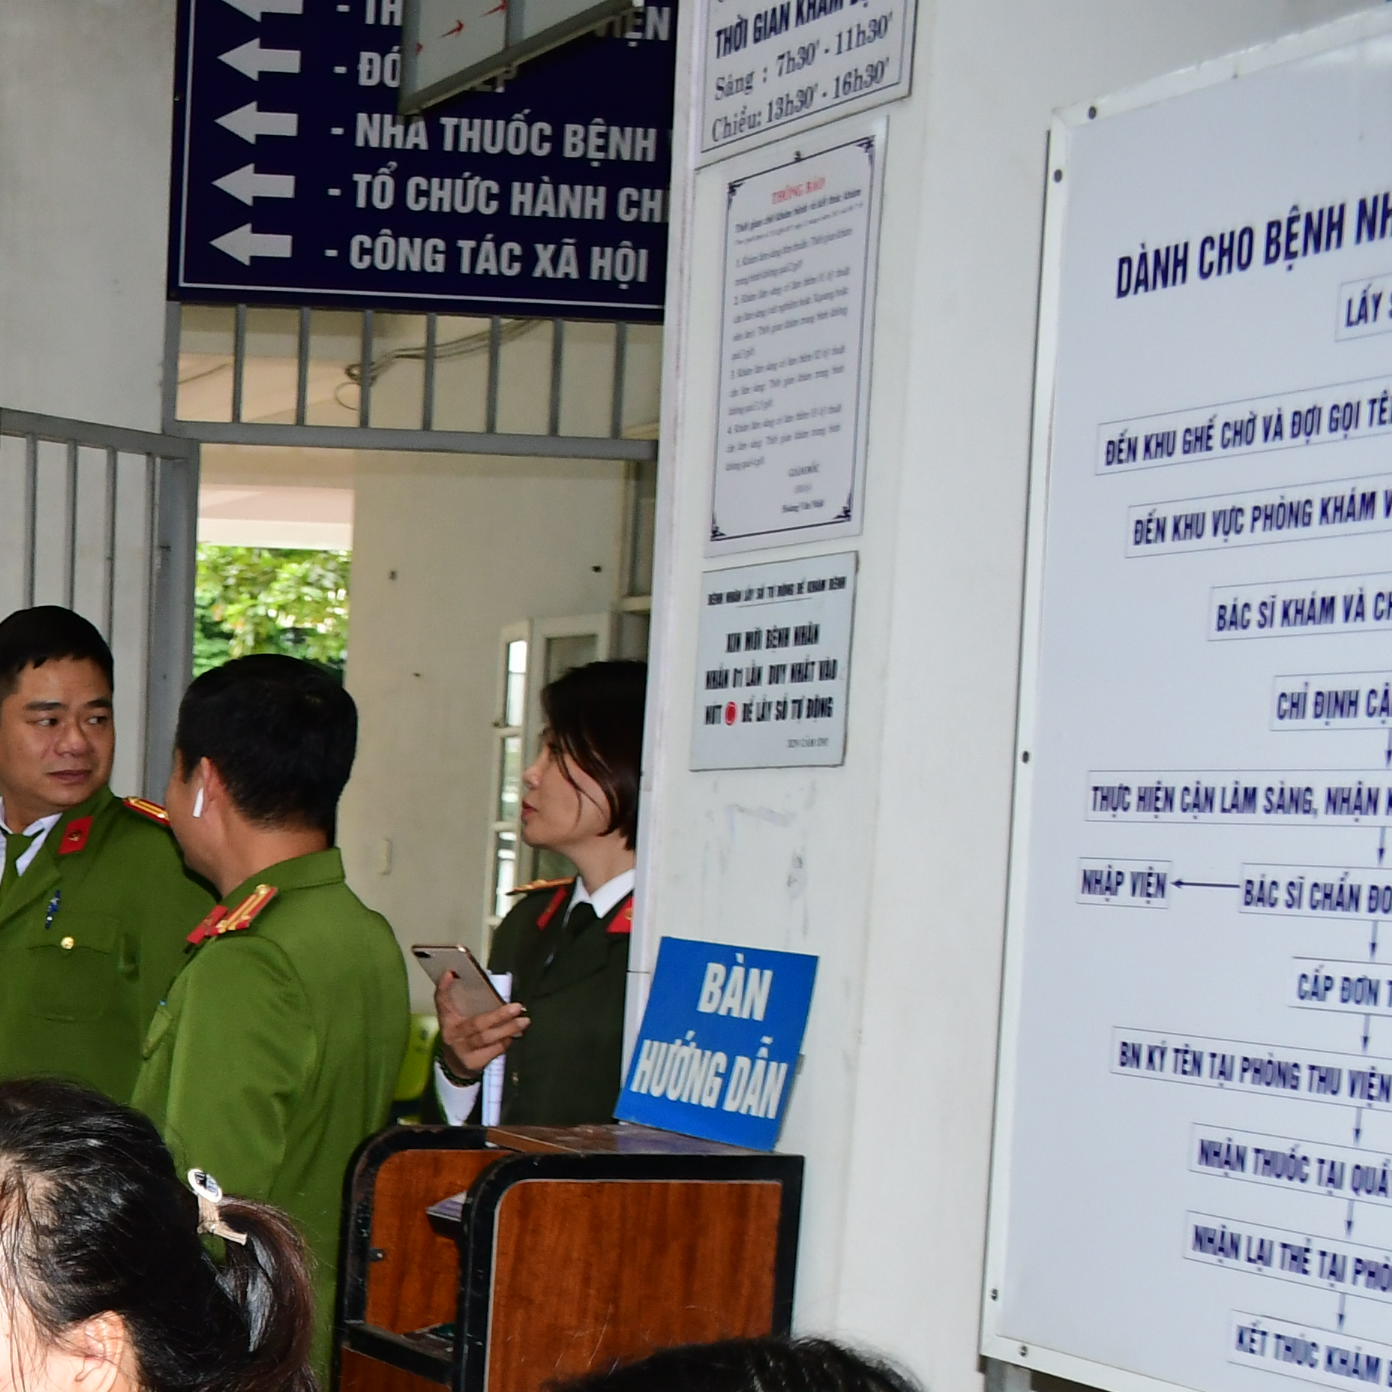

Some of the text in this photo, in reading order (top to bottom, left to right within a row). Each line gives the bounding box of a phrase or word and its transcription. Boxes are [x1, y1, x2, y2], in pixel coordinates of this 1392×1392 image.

[716, 1, 791, 59] THỜI GIAN
[440, 109, 657, 167] THUỐC BỆNH
[353, 161, 606, 220] TỔ CHỨC HÀNH
[349, 228, 648, 289] CÔNG TÁC XÃ HỘI
[1116, 242, 1189, 299] DÀNH
[1197, 226, 1255, 280] CHO
[1264, 205, 1346, 271] BỆNH
[1345, 283, 1383, 328] LẤY
[1105, 400, 1361, 466] ĐẾN KHU GHẾ CHỜ VÀ ĐỢI GỌI
[1133, 487, 1377, 545] ĐẾN KHU VỰC PHÒNG KHÁM
[1216, 587, 1366, 632] BÁC SĨ KHÁM VÀ
[1313, 688, 1360, 727] ĐỊNH
[1136, 780, 1175, 819] HIỆN
[1180, 780, 1216, 820] CẬN
[1220, 779, 1258, 814] LÂM
[1325, 780, 1381, 823] NHẬN
[1080, 864, 1168, 905] NHẬP VIỆN
[1243, 873, 1280, 908] BÁC
[1285, 875, 1305, 910] SĨ
[696, 952, 773, 1021] BÀN
[1297, 964, 1334, 1003] CẤP
[629, 1030, 788, 1119] HƯỚNG DẪN
[1119, 1041, 1142, 1069] BN
[1173, 1043, 1204, 1078] TÊN
[1209, 1052, 1235, 1088] TẠI
[1240, 1052, 1300, 1091] PHÒNG
